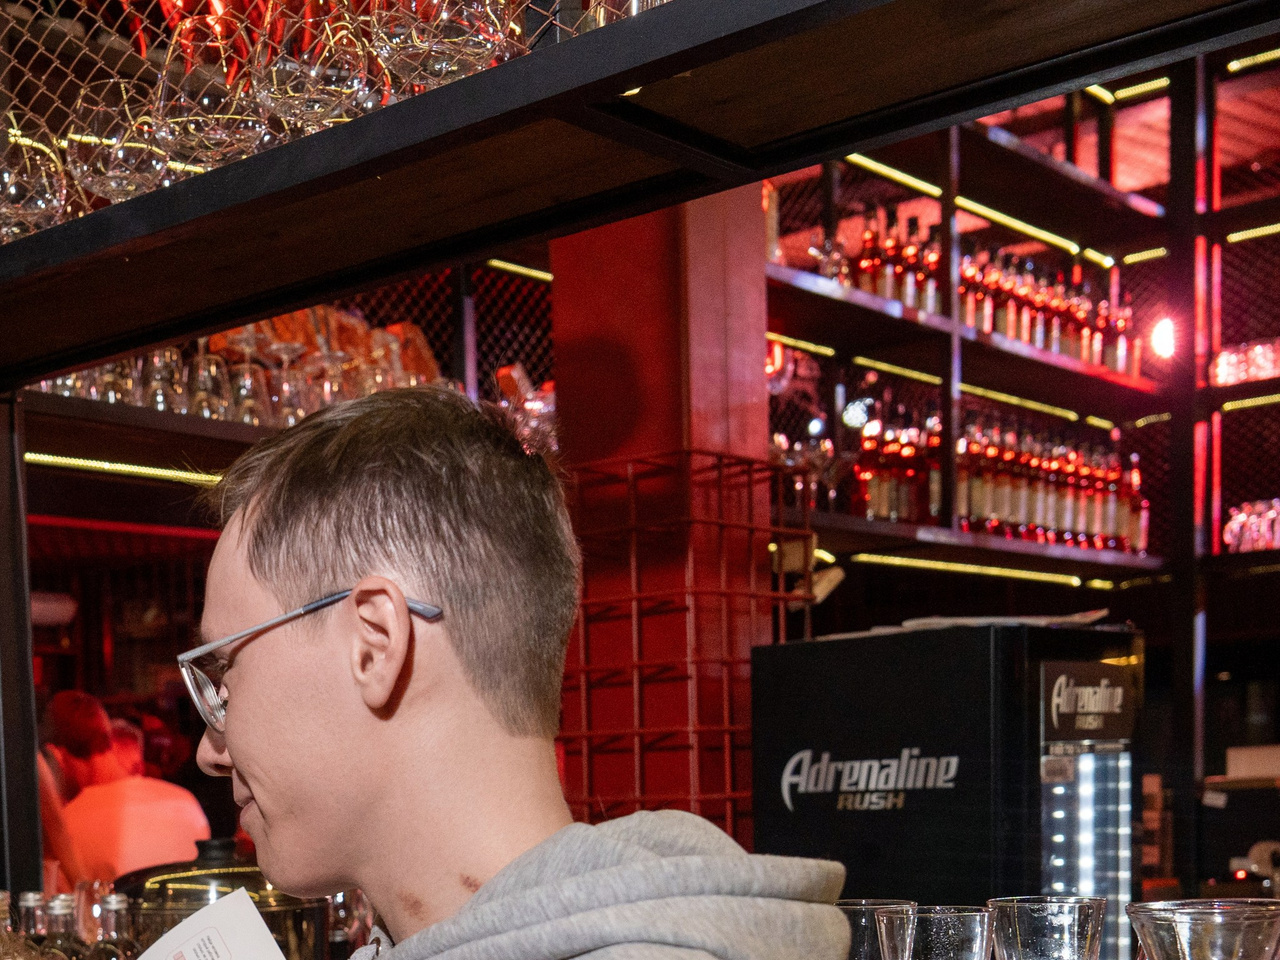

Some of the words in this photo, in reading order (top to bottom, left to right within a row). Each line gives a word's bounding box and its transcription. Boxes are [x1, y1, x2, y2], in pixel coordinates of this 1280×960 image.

[1051, 674, 1124, 729] Adrenaline
[780, 747, 959, 813] Adrenaline
[837, 791, 906, 811] RUSH
